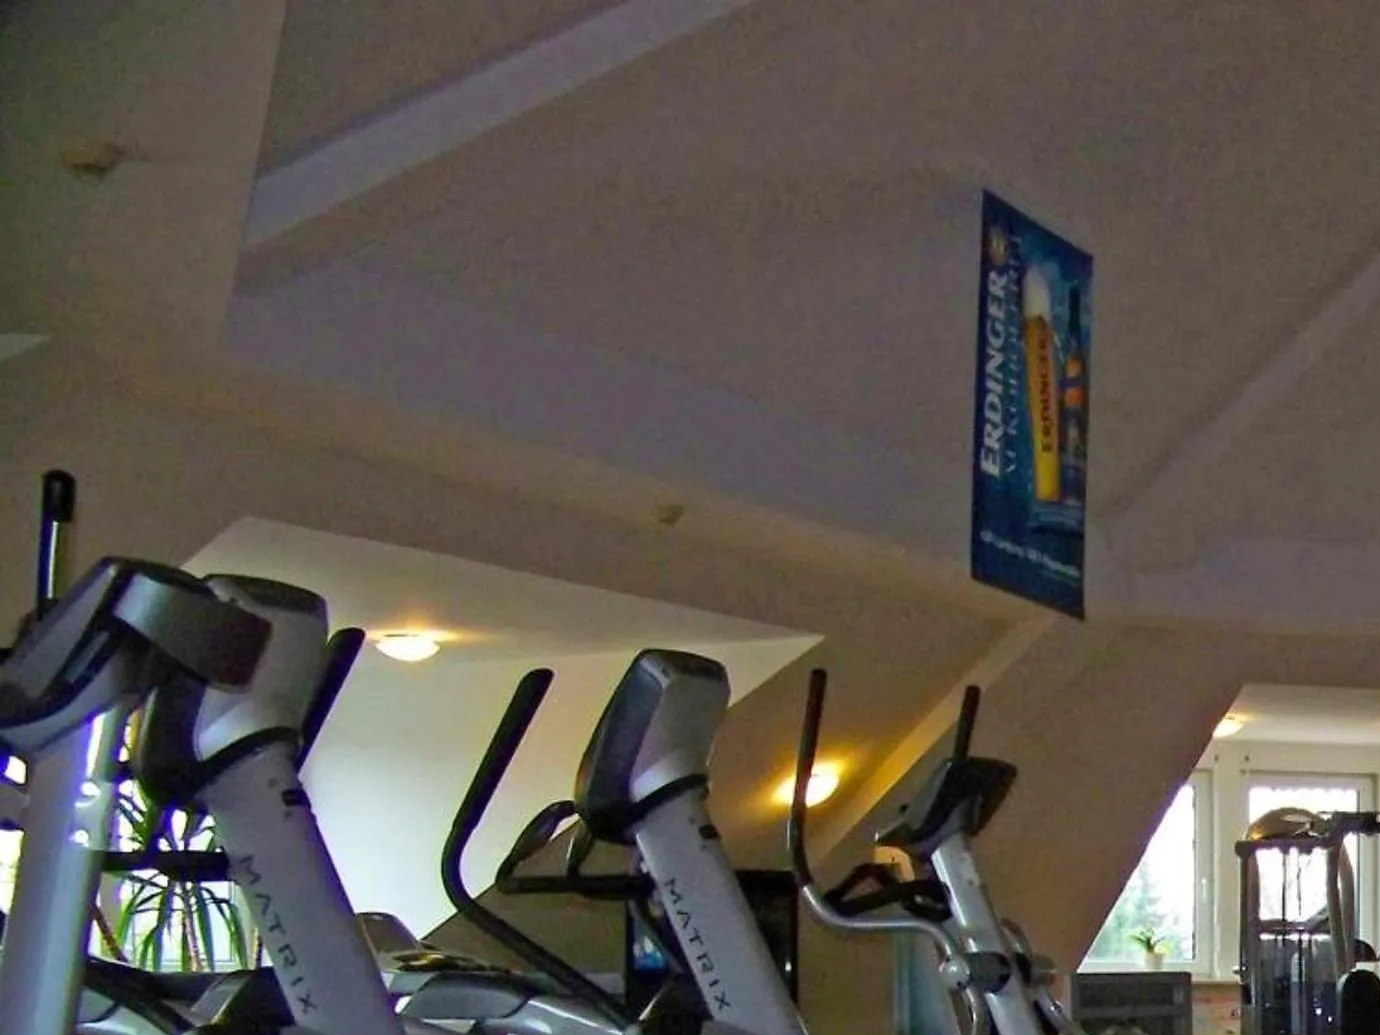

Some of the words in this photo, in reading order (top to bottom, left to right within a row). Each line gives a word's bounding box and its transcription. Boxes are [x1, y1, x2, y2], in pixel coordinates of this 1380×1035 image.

[980, 269, 1007, 479] ERDINGER
[236, 854, 317, 1014] MATRIX
[664, 877, 730, 1012] MATRIX
